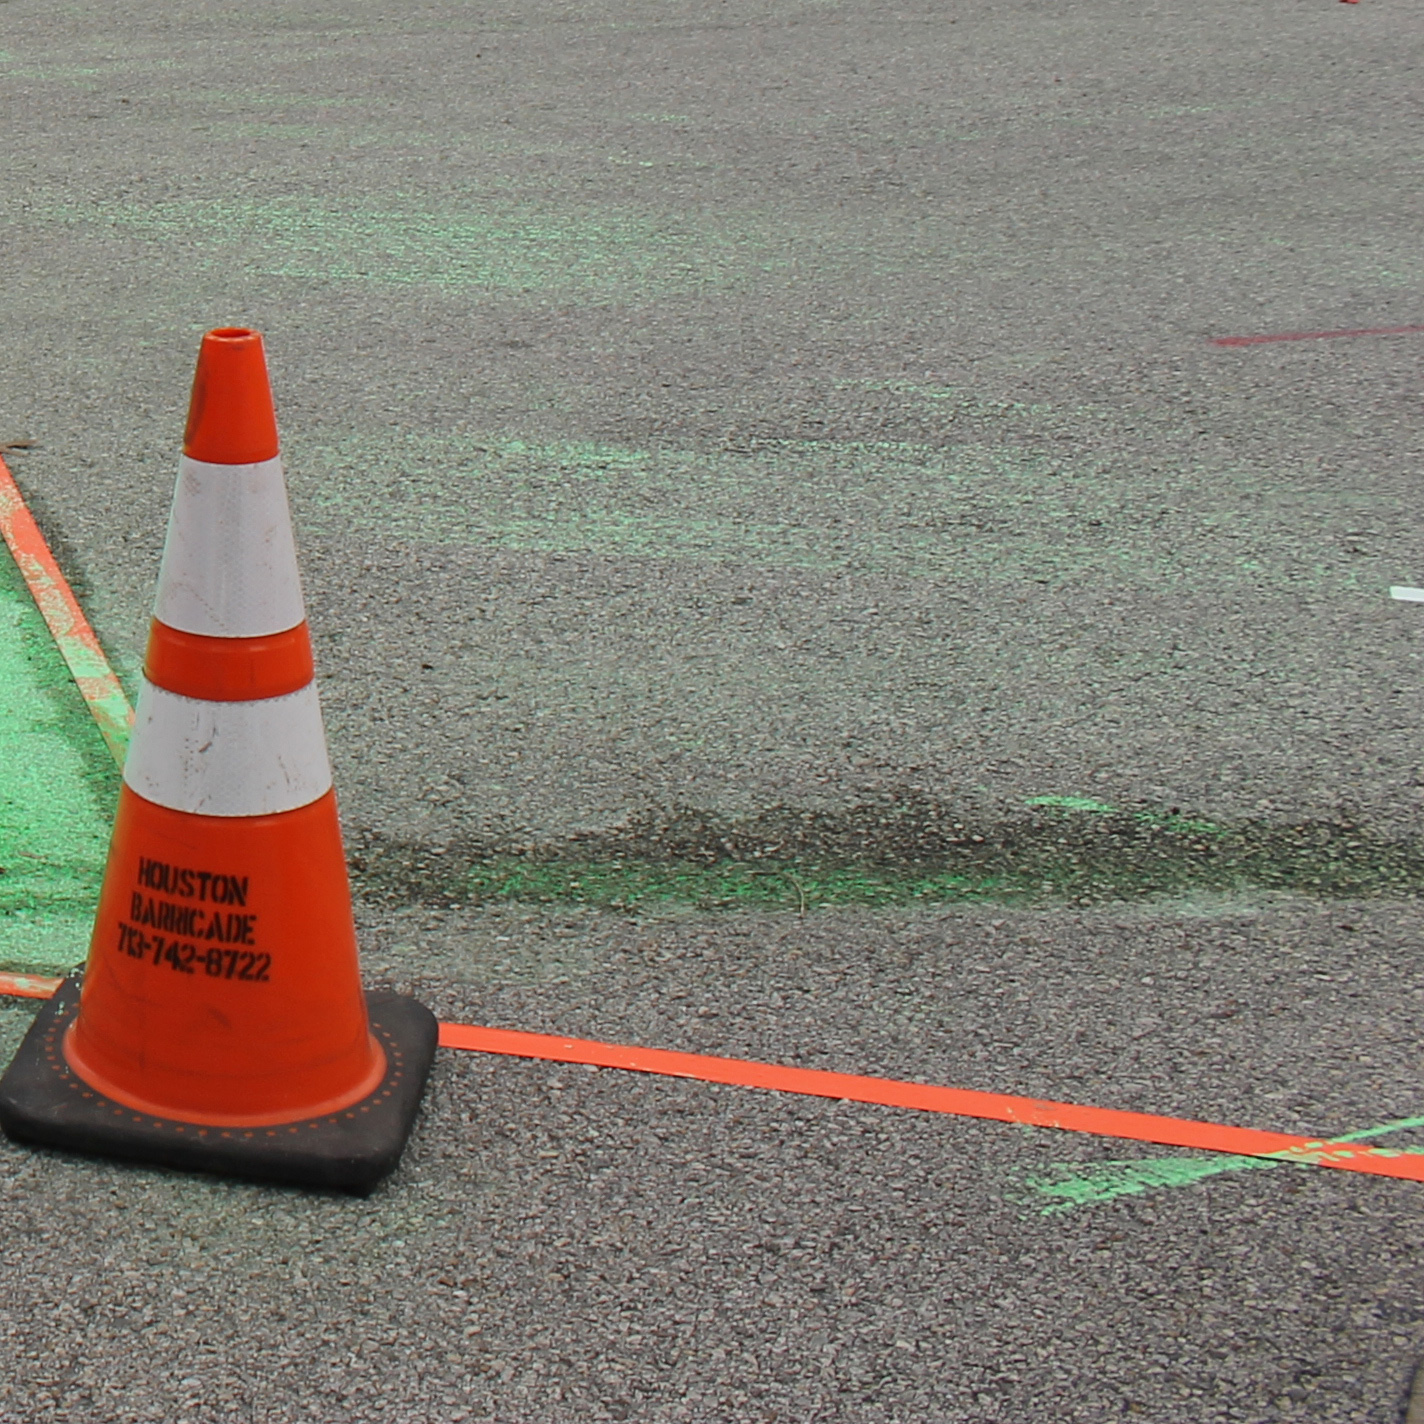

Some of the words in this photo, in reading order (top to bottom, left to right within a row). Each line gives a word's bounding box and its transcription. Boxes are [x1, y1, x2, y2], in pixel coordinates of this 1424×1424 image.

[137, 855, 249, 907] HOUSTON
[130, 890, 258, 946] BARRICADE
[117, 921, 272, 982] 713-742-8722
